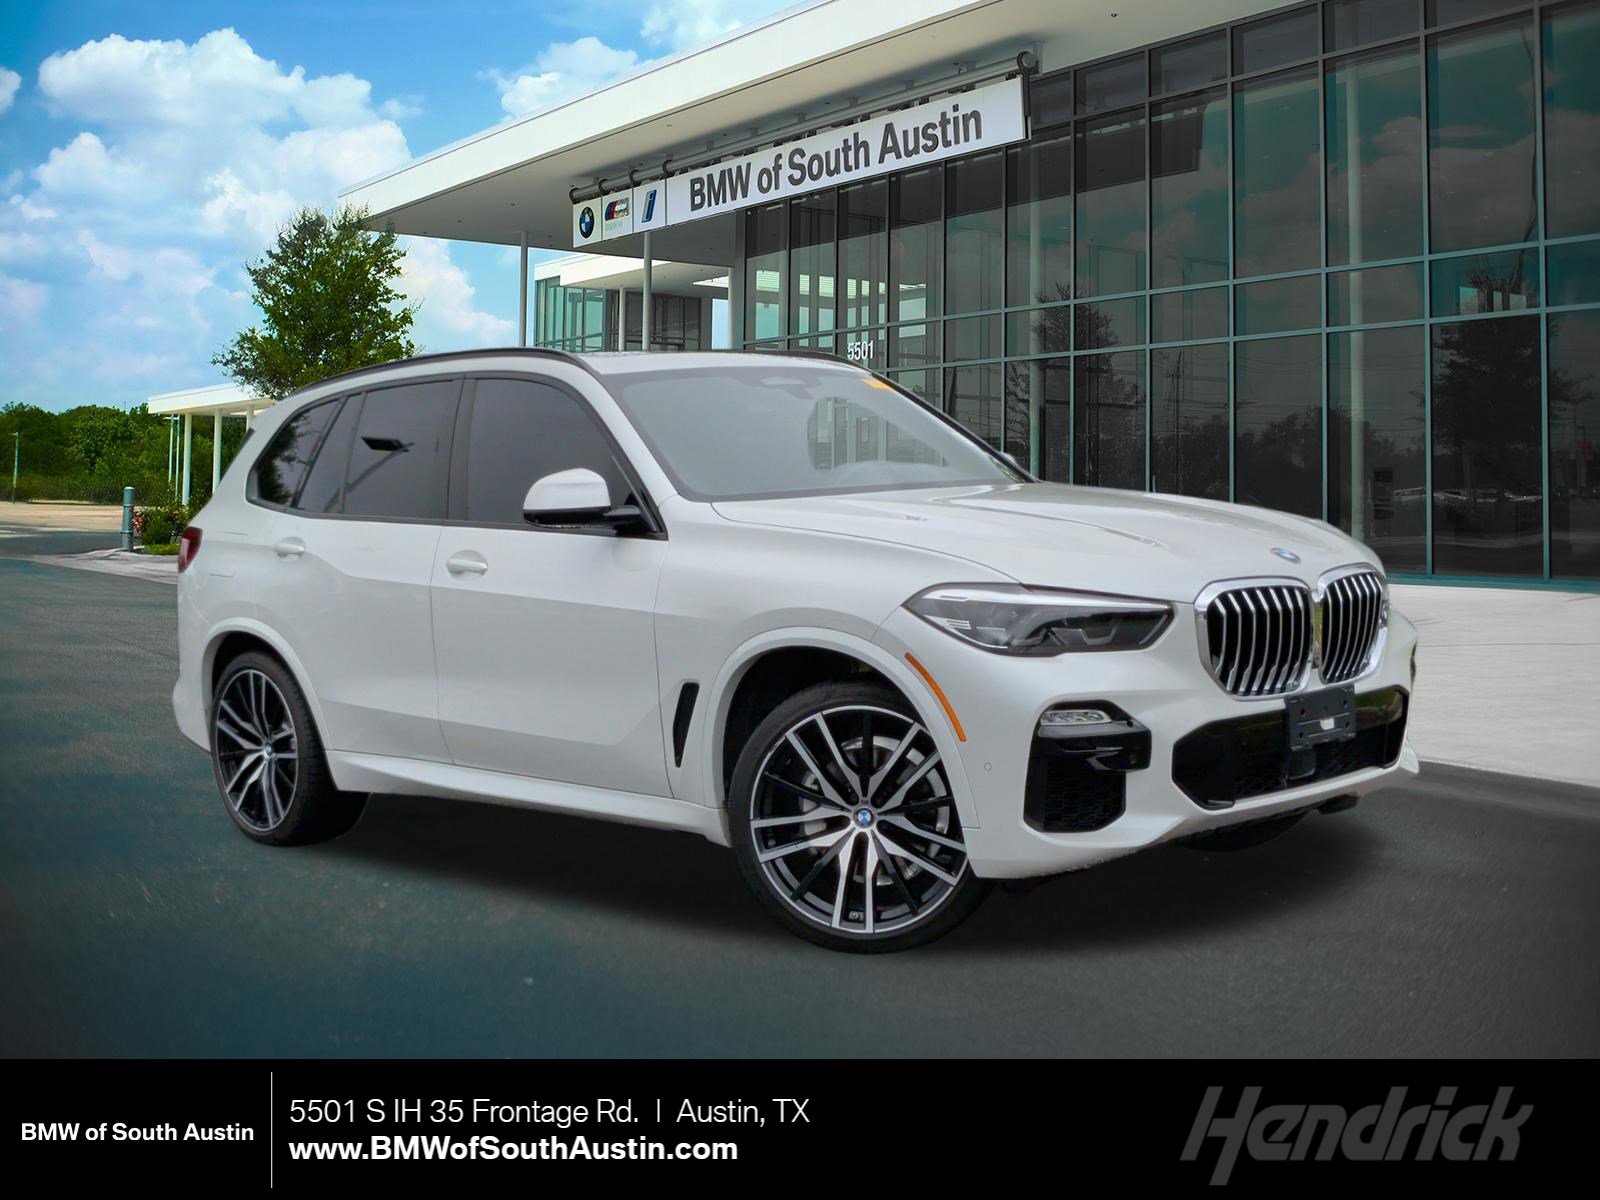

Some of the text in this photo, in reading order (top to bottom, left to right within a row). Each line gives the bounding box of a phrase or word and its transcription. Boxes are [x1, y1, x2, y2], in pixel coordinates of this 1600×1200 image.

[690, 104, 983, 212] BMW of South Austin
[847, 340, 874, 361] 5501
